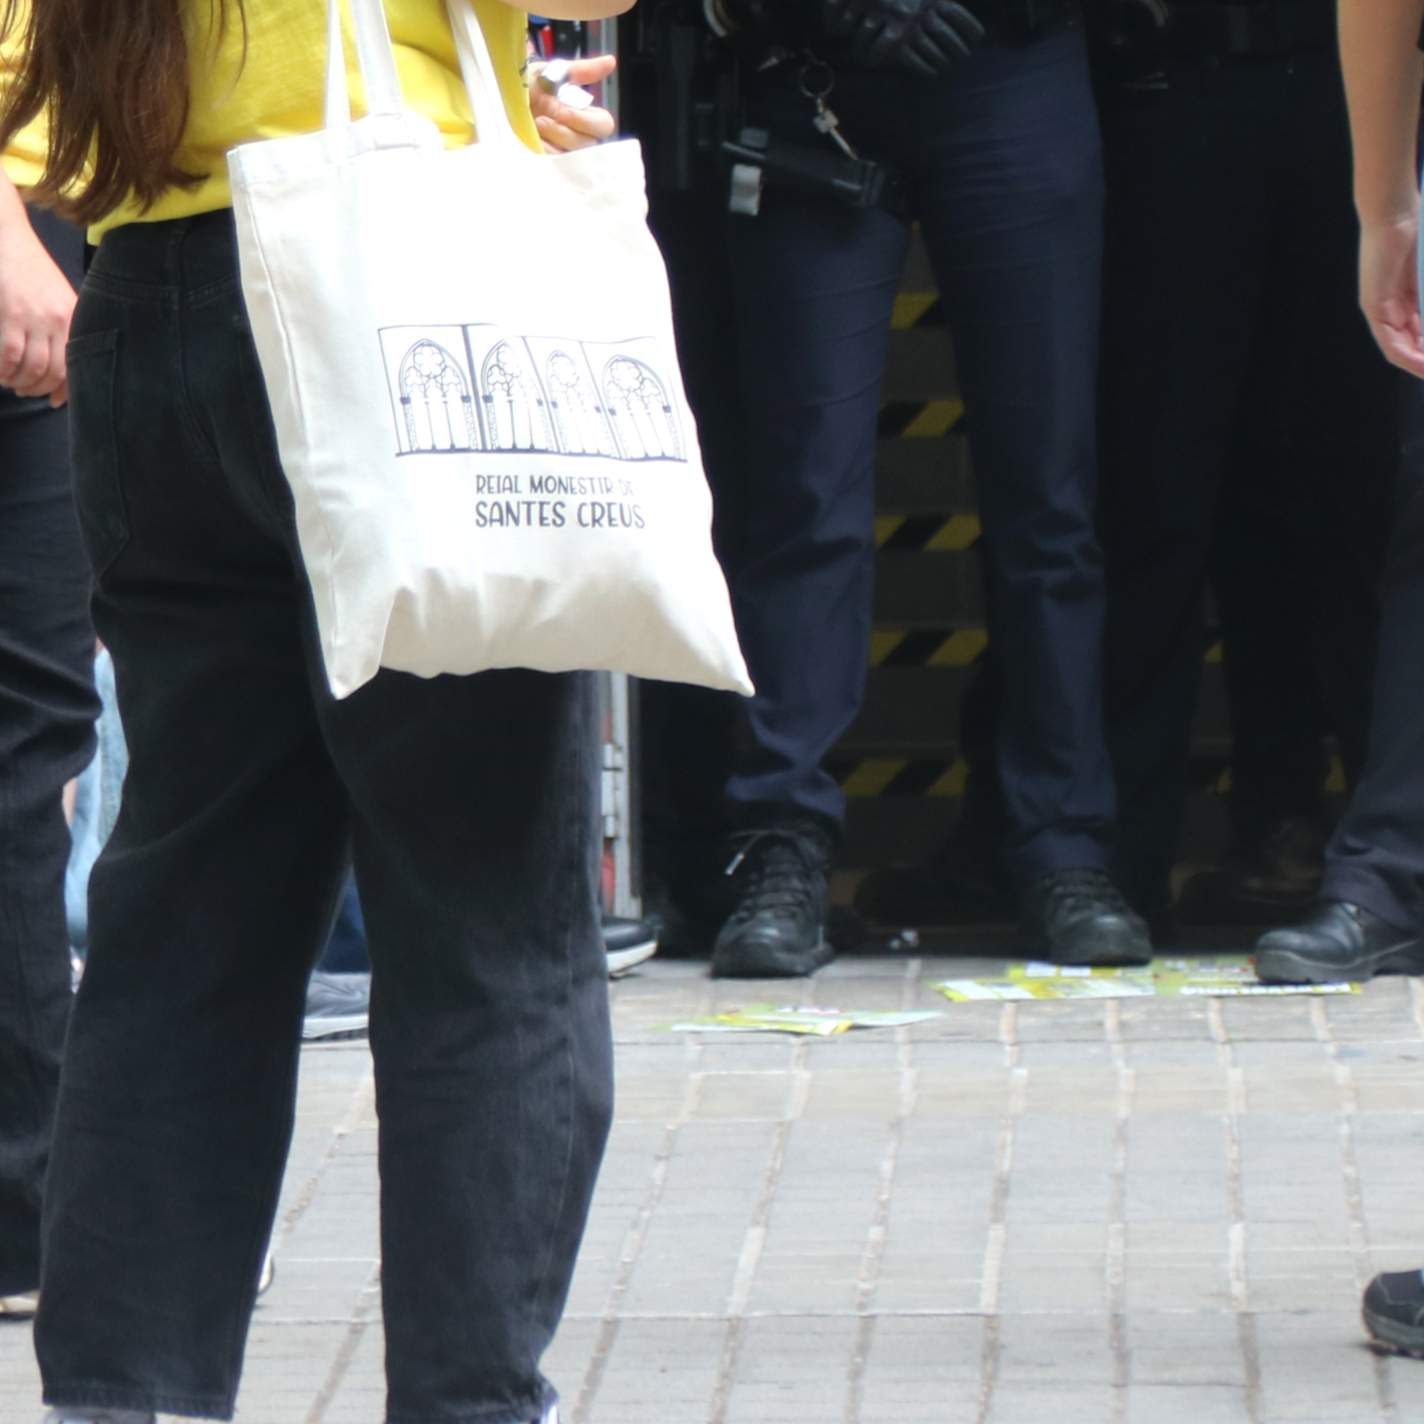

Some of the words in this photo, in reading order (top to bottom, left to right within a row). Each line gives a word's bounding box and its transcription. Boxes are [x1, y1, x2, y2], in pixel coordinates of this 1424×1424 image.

[475, 474, 522, 495] REIAL
[529, 474, 613, 496] MONESTIR
[475, 500, 566, 528] SANTES
[577, 501, 646, 529] CREUS
